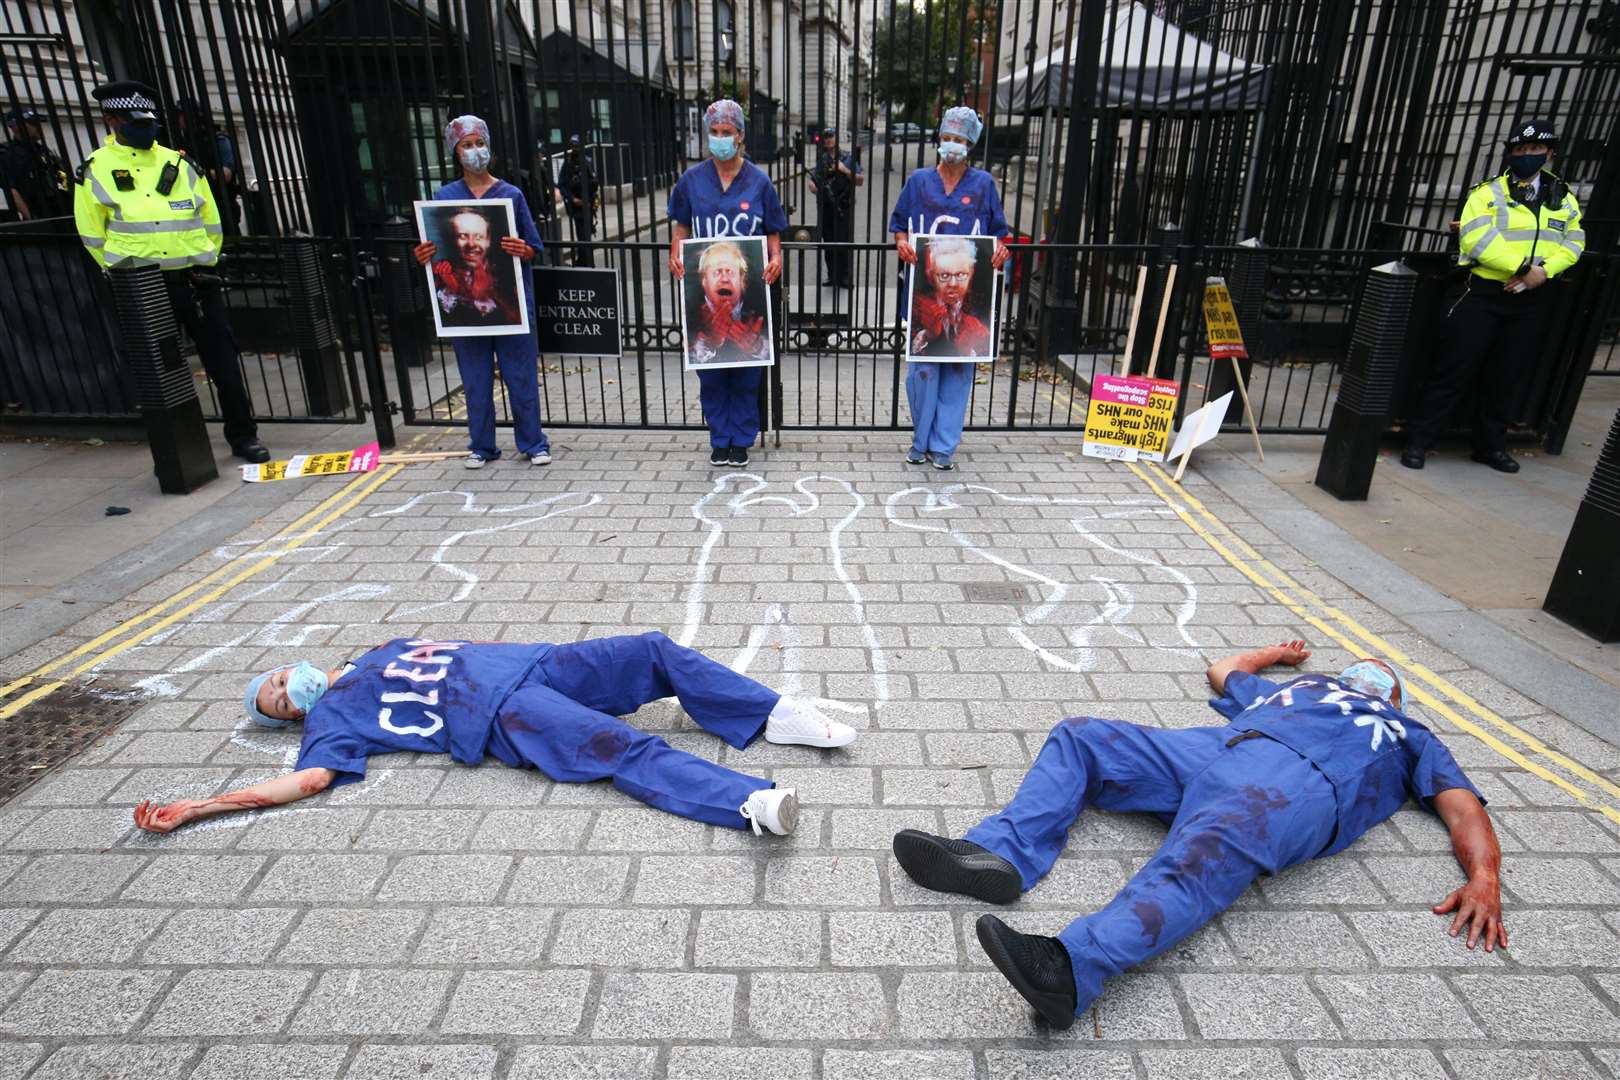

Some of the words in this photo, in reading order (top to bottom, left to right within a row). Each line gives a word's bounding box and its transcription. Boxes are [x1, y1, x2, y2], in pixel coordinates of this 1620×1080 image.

[558, 289, 596, 301] KEEP
[539, 306, 616, 319] ENTRANCE
[553, 322, 602, 335] CLEAR
[1118, 393, 1129, 402] the
[1130, 393, 1147, 405] Stop
[1096, 404, 1122, 417] NHS
[1148, 396, 1173, 415] rise
[1123, 407, 1143, 418] our
[1110, 418, 1140, 430] make
[1143, 414, 1168, 433] NHS
[1088, 428, 1138, 446] Migrants
[1139, 431, 1164, 452] Figh
